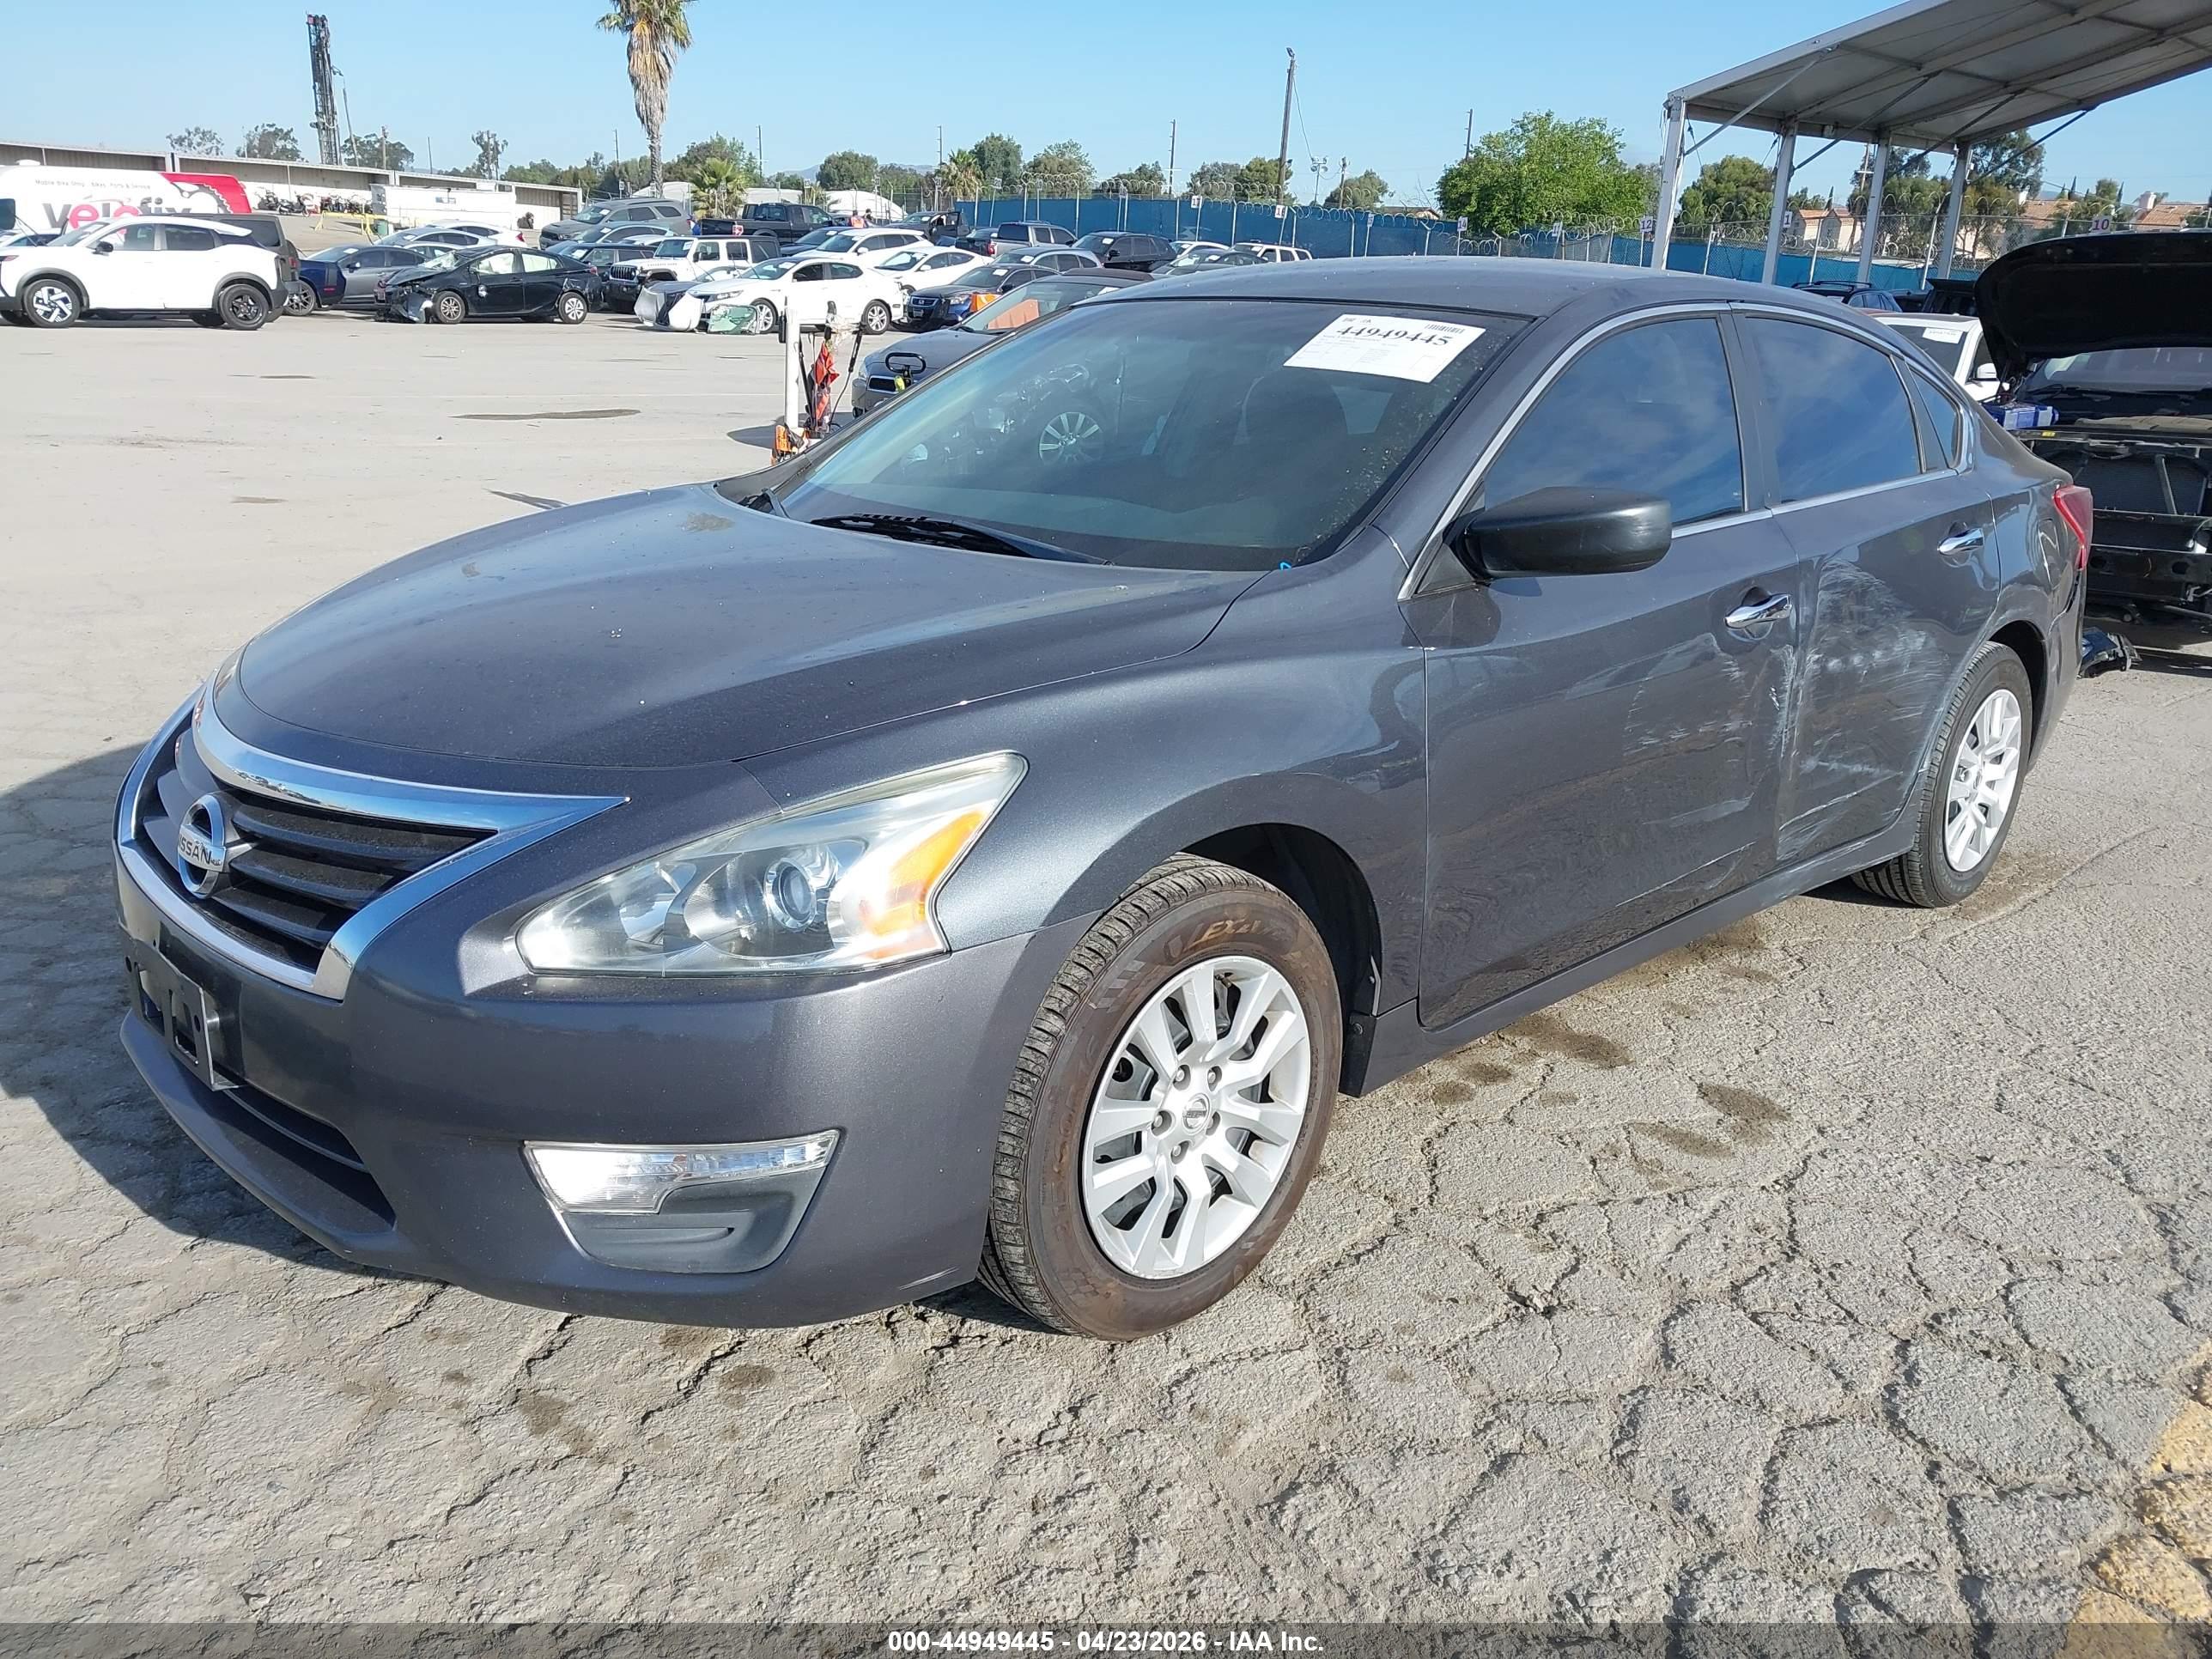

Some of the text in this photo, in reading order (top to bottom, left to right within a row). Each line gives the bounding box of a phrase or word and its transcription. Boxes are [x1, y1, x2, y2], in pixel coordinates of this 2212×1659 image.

[1641, 219, 1652, 229] 12
[2093, 219, 2110, 231] 10
[1336, 325, 1455, 346] 44949445
